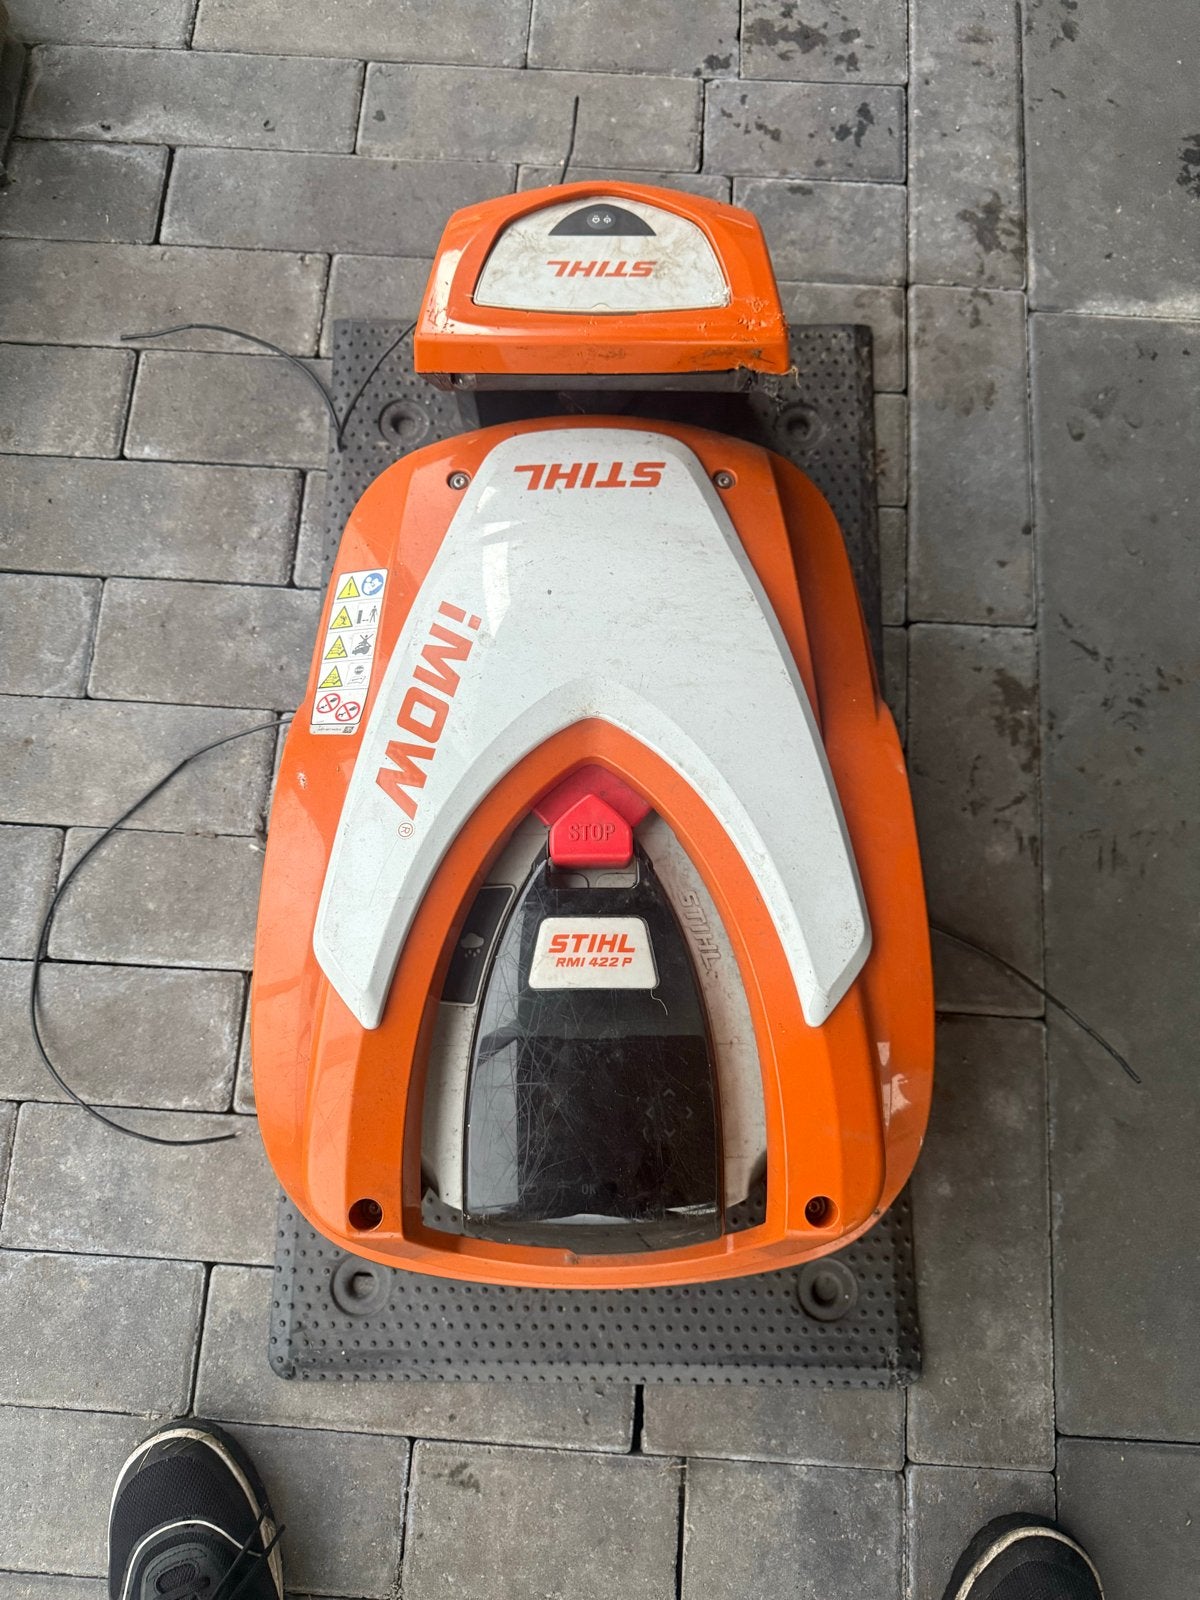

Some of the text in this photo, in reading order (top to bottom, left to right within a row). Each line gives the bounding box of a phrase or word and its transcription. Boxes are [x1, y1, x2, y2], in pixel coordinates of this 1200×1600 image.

[547, 261, 656, 277] STIHL
[514, 462, 666, 490] STIHL
[568, 822, 616, 842] STOP
[680, 888, 722, 972] STIHL
[548, 933, 636, 954] STIHL
[555, 957, 633, 968] RMI 422 P
